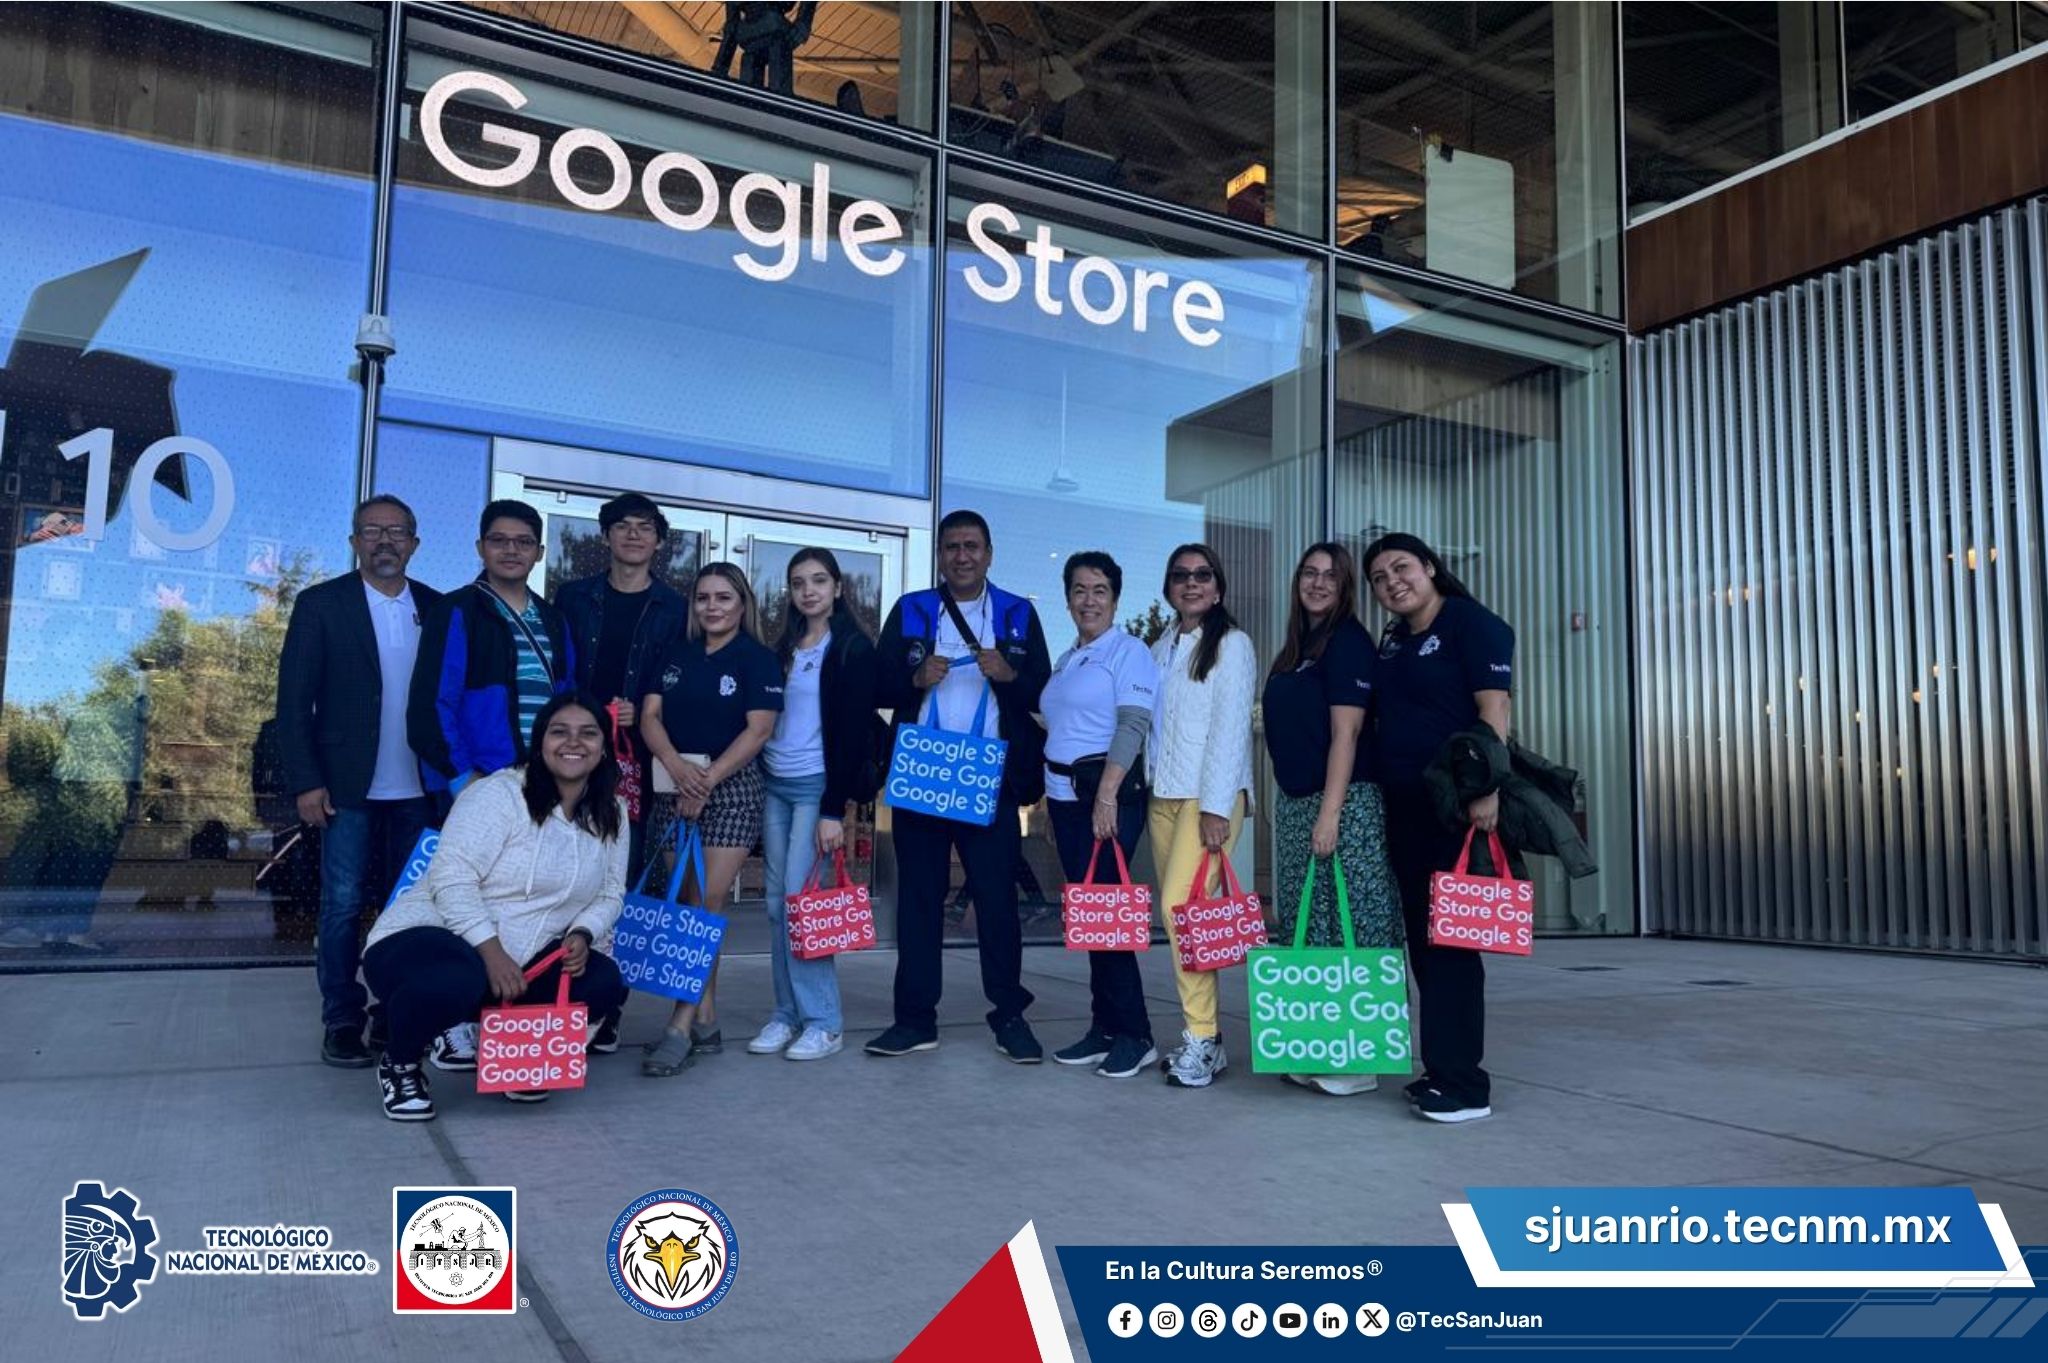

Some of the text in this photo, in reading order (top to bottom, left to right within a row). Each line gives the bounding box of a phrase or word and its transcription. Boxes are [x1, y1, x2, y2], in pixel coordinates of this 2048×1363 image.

[419, 70, 1225, 347] Google Store
[57, 427, 235, 551] 10
[900, 728, 977, 762] Google
[894, 752, 952, 781] Store
[889, 777, 968, 812] Google
[800, 891, 854, 912] Google
[1068, 887, 1130, 907] Google
[1439, 875, 1512, 902] Google
[1069, 906, 1113, 923] Store
[1188, 900, 1245, 922] Google
[1438, 896, 1491, 919] Store
[676, 909, 721, 942] Store
[802, 914, 842, 933] Store
[1192, 926, 1234, 943] Store
[1437, 917, 1511, 946] Google
[805, 928, 860, 951] Google
[1068, 927, 1131, 948] Google
[651, 934, 712, 969] Google
[1196, 940, 1252, 963] Google
[659, 963, 702, 993] Store
[1253, 956, 1370, 992] Google
[1256, 992, 1341, 1021] Store
[483, 1012, 564, 1038] Google
[483, 1039, 541, 1059] Store
[1257, 1028, 1376, 1068] Google
[481, 1061, 562, 1086] Google
